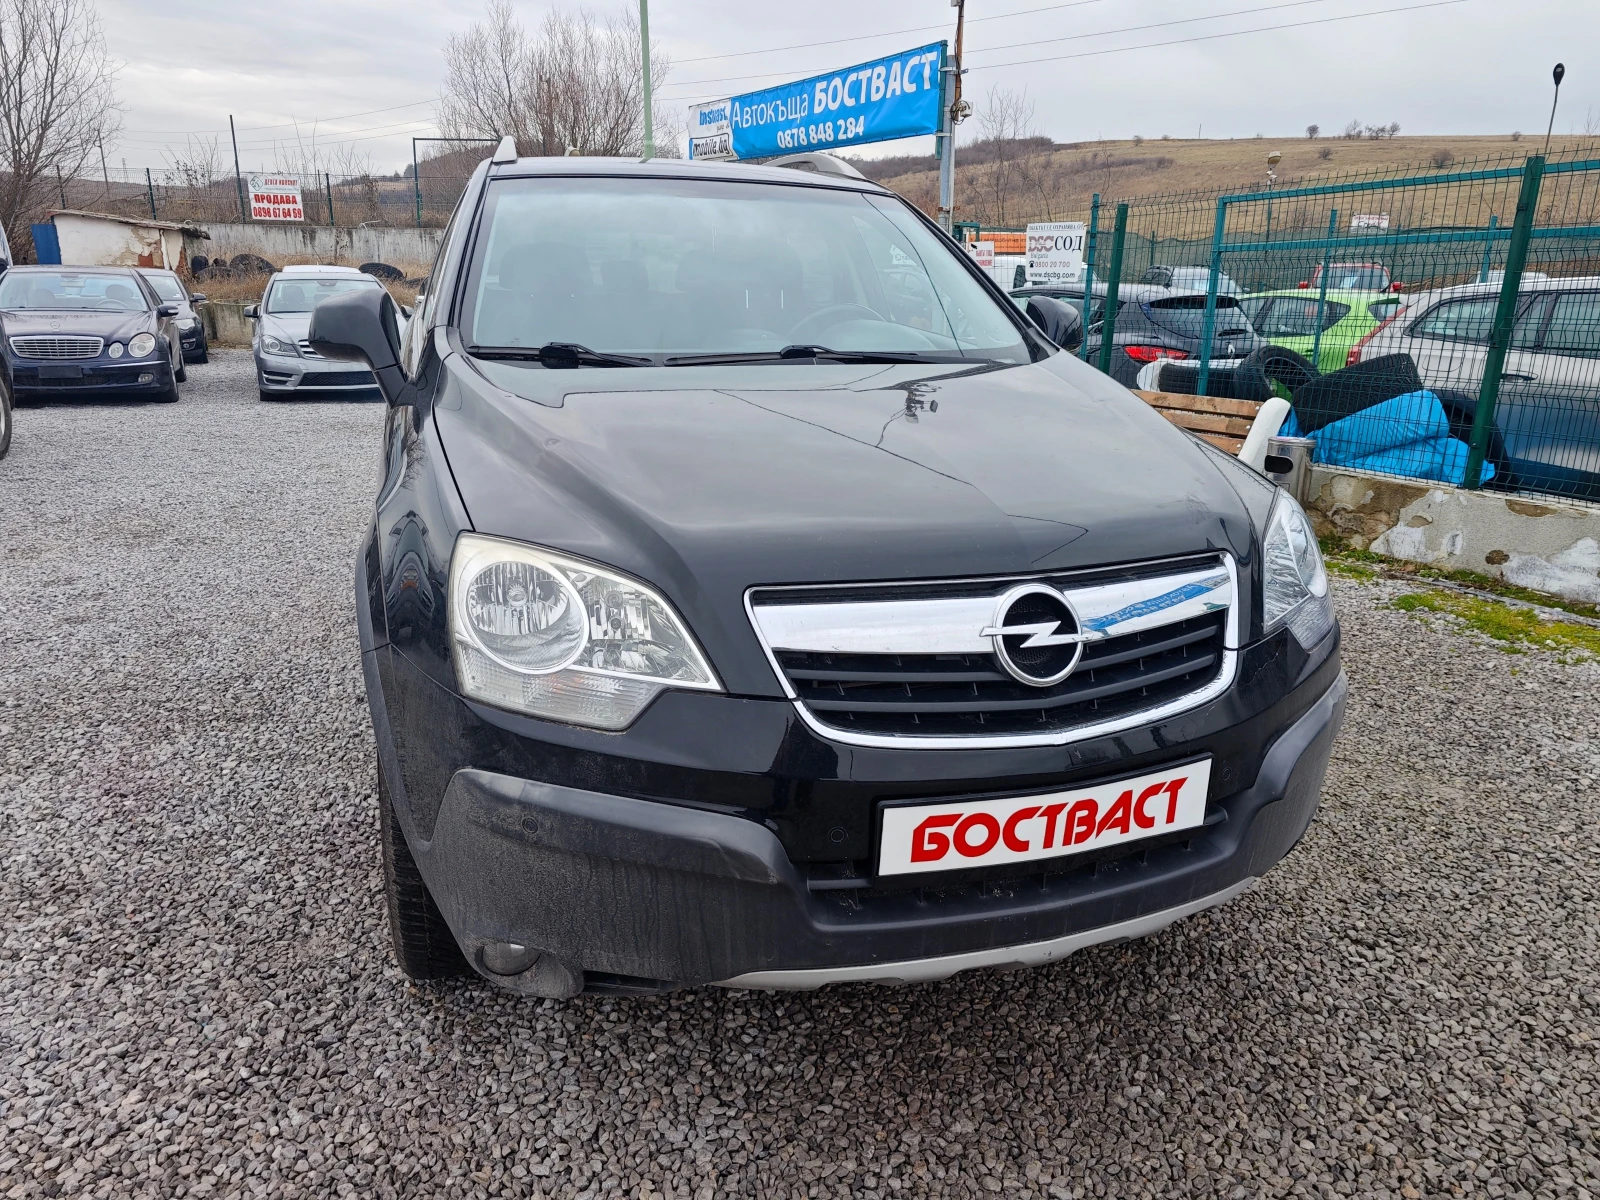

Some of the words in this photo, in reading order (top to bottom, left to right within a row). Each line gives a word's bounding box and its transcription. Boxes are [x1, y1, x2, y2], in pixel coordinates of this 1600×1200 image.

[813, 51, 938, 114] БОСТВАСТ
[777, 127, 807, 149] 0878
[808, 122, 834, 145] 848
[836, 115, 866, 140] 284
[253, 193, 298, 205] ПРОДАВА
[253, 206, 271, 218] 0898
[272, 207, 280, 218] 67
[282, 207, 291, 218] 64
[1028, 235, 1054, 252] DSC
[1054, 235, 1083, 253] СОД
[1030, 271, 1075, 280] www.dscbg.com
[910, 776, 1189, 863] БОСТВАСТ
